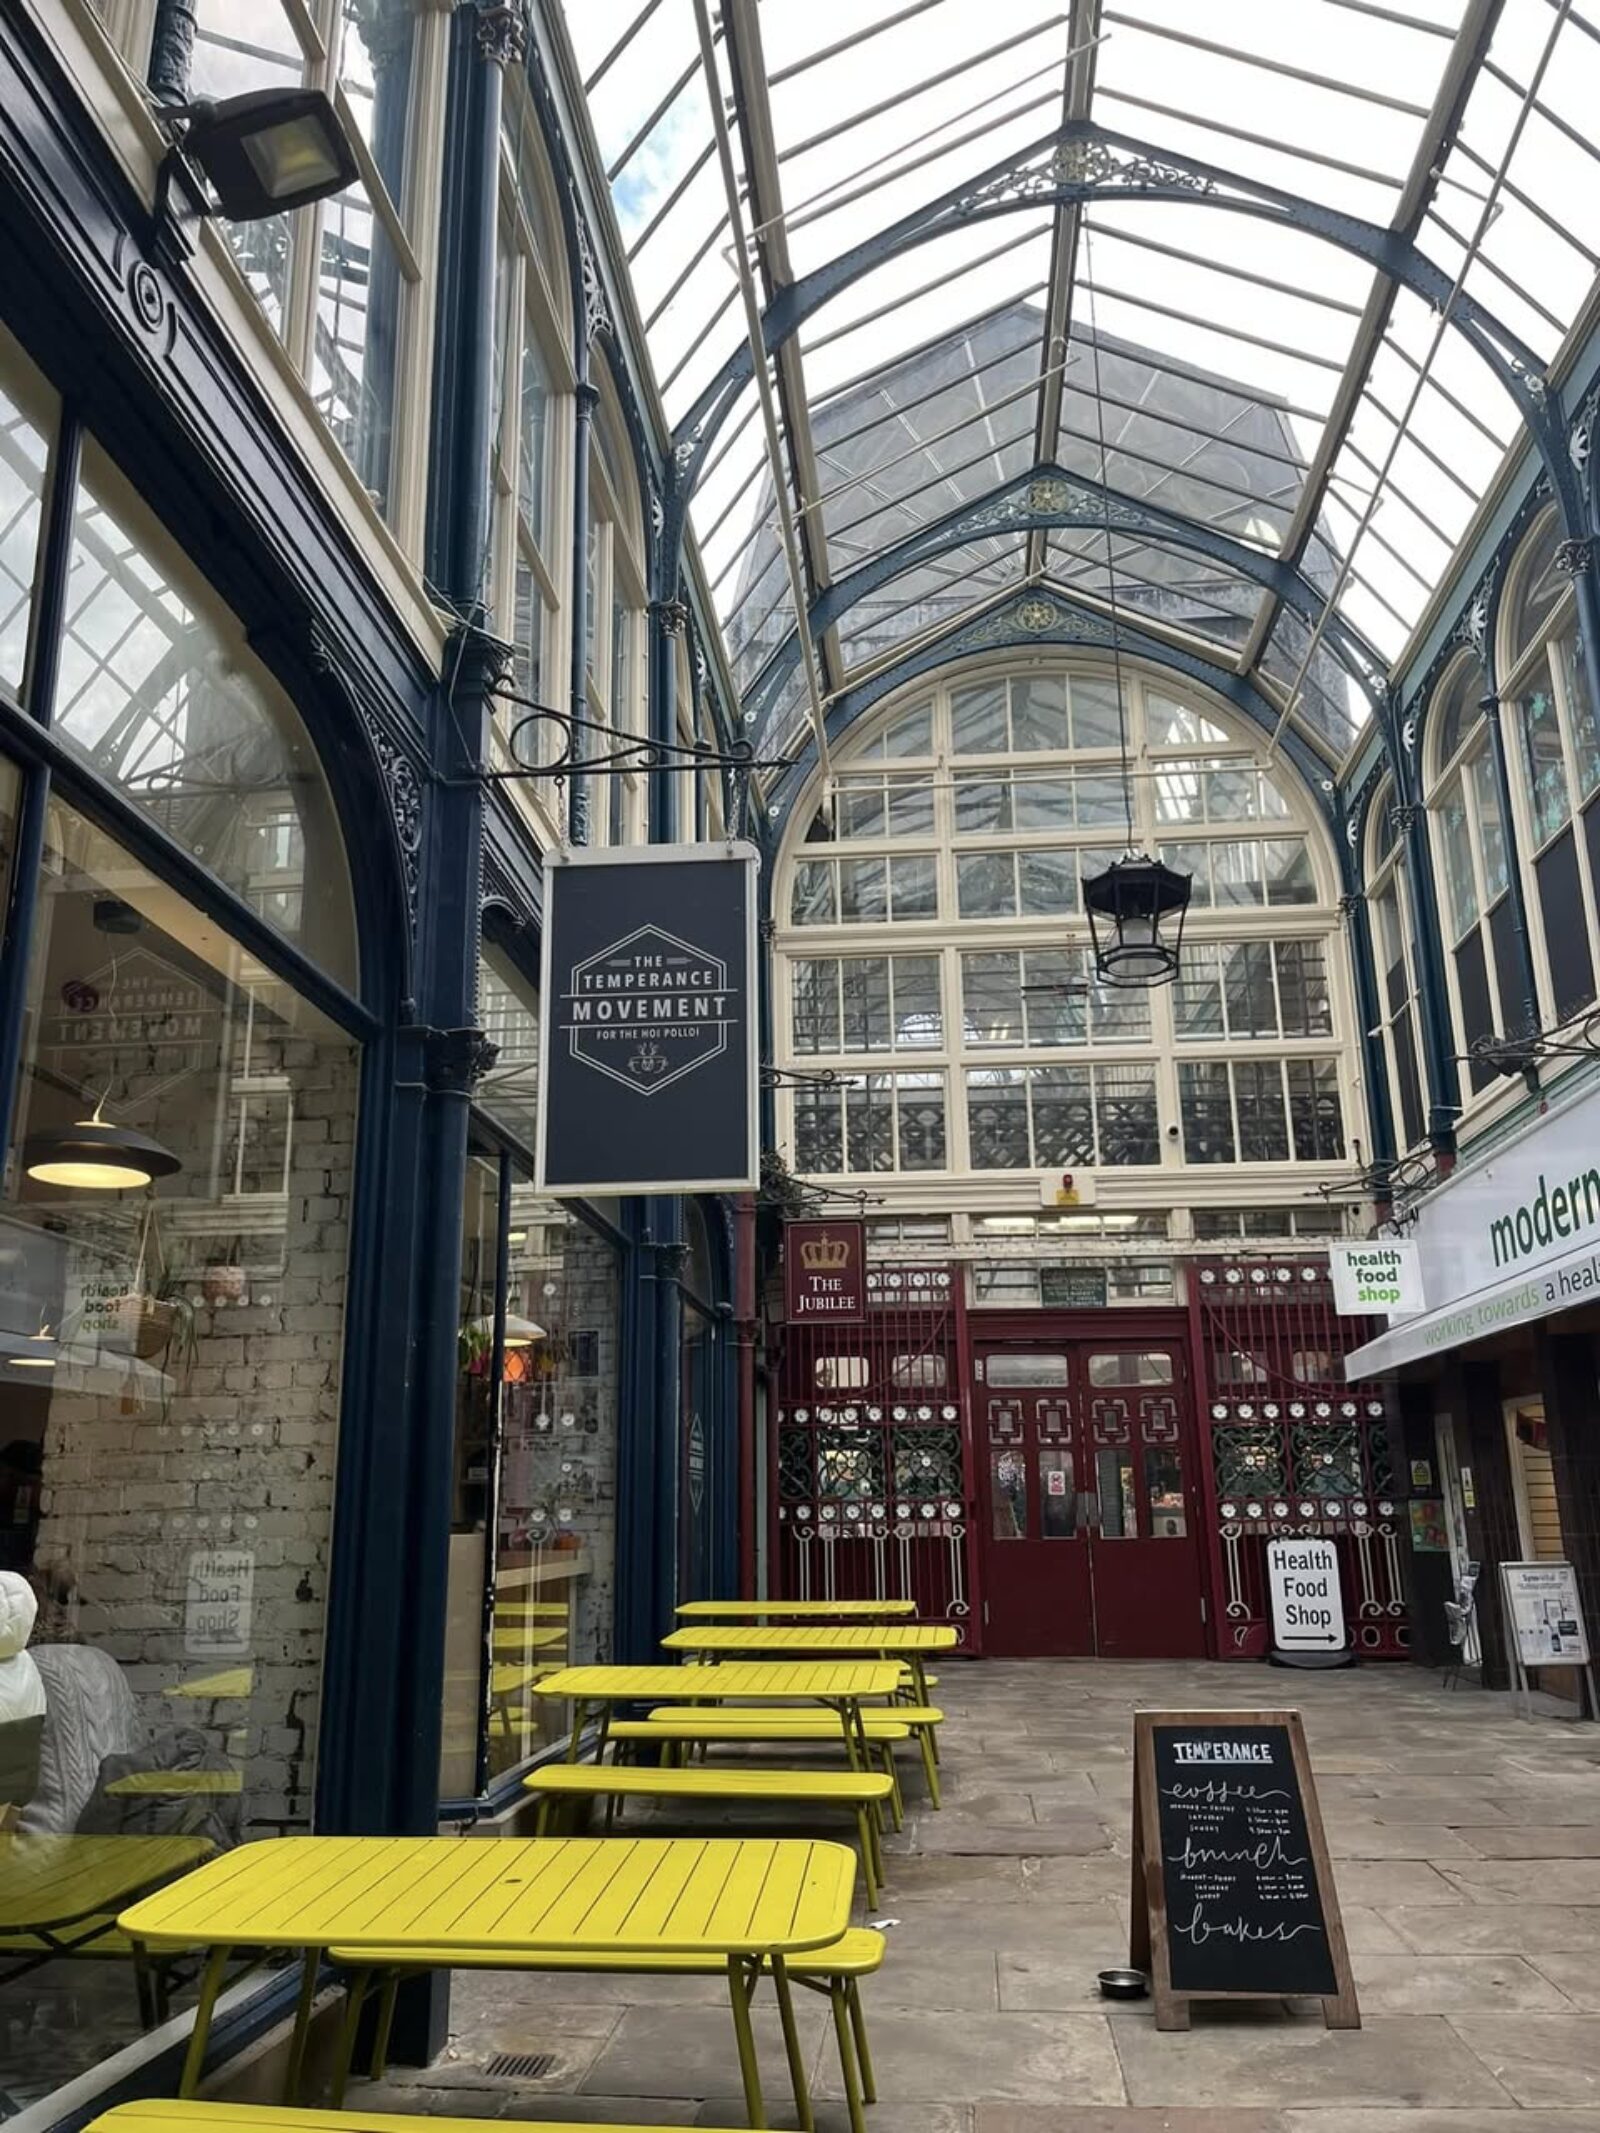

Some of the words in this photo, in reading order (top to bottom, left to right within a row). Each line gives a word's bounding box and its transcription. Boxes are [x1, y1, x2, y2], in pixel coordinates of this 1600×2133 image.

[634, 956, 663, 968] THE
[584, 970, 713, 990] TEMPERANCE
[572, 997, 726, 1021] MOVEMENT
[596, 1030, 617, 1040] FOR
[619, 1029, 638, 1039] THE
[641, 1028, 661, 1038] HOI
[664, 1026, 700, 1038] POLLOI
[1490, 1168, 1600, 1268] modern
[1347, 1250, 1401, 1266] health
[1356, 1268, 1398, 1283] food
[1358, 1286, 1401, 1303] shop
[1424, 1312, 1474, 1346] working
[1478, 1286, 1541, 1326] towards
[1545, 1281, 1556, 1301] a
[1274, 1549, 1333, 1571] Health
[1284, 1577, 1328, 1598] Food
[1285, 1605, 1331, 1628] Shop
[1173, 1742, 1272, 1761] TEMPERANCE
[1161, 1780, 1292, 1802] coffee
[1168, 1836, 1306, 1869] brunch
[1174, 1902, 1321, 1944] bakes
